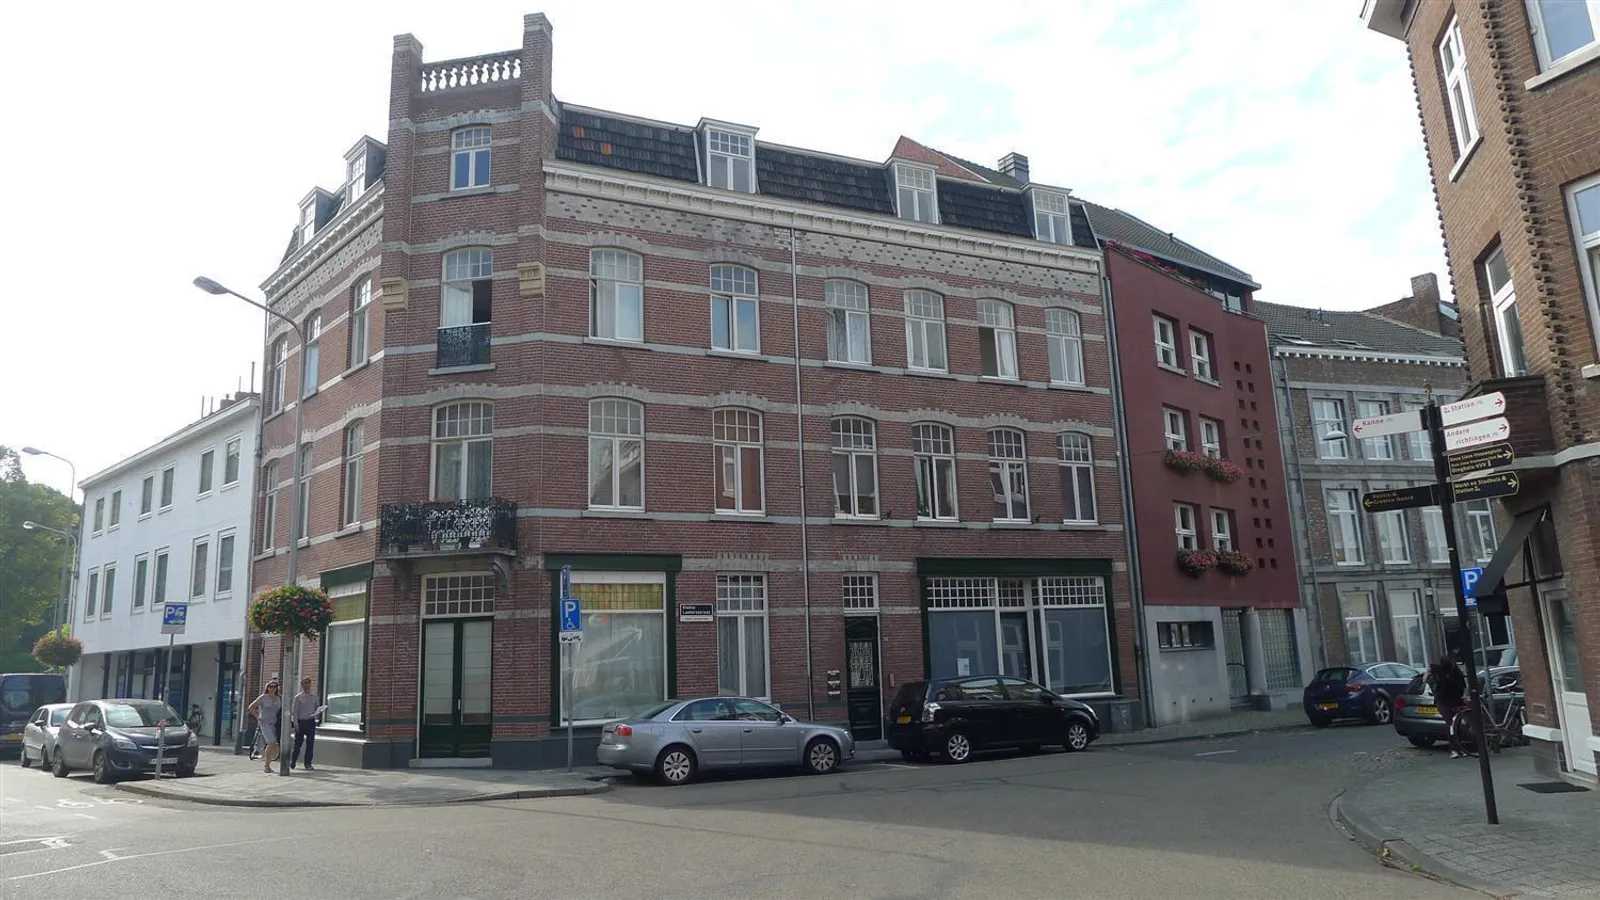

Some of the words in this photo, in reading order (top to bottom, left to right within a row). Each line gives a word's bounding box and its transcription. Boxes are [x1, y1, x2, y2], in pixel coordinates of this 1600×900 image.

[1450, 401, 1475, 412] Station
[1446, 428, 1470, 438] Andere
[1456, 433, 1491, 445] richtingen
[1478, 477, 1501, 485] Stadhuis
[1464, 571, 1478, 589] P
[165, 606, 175, 618] P
[565, 601, 576, 617] P
